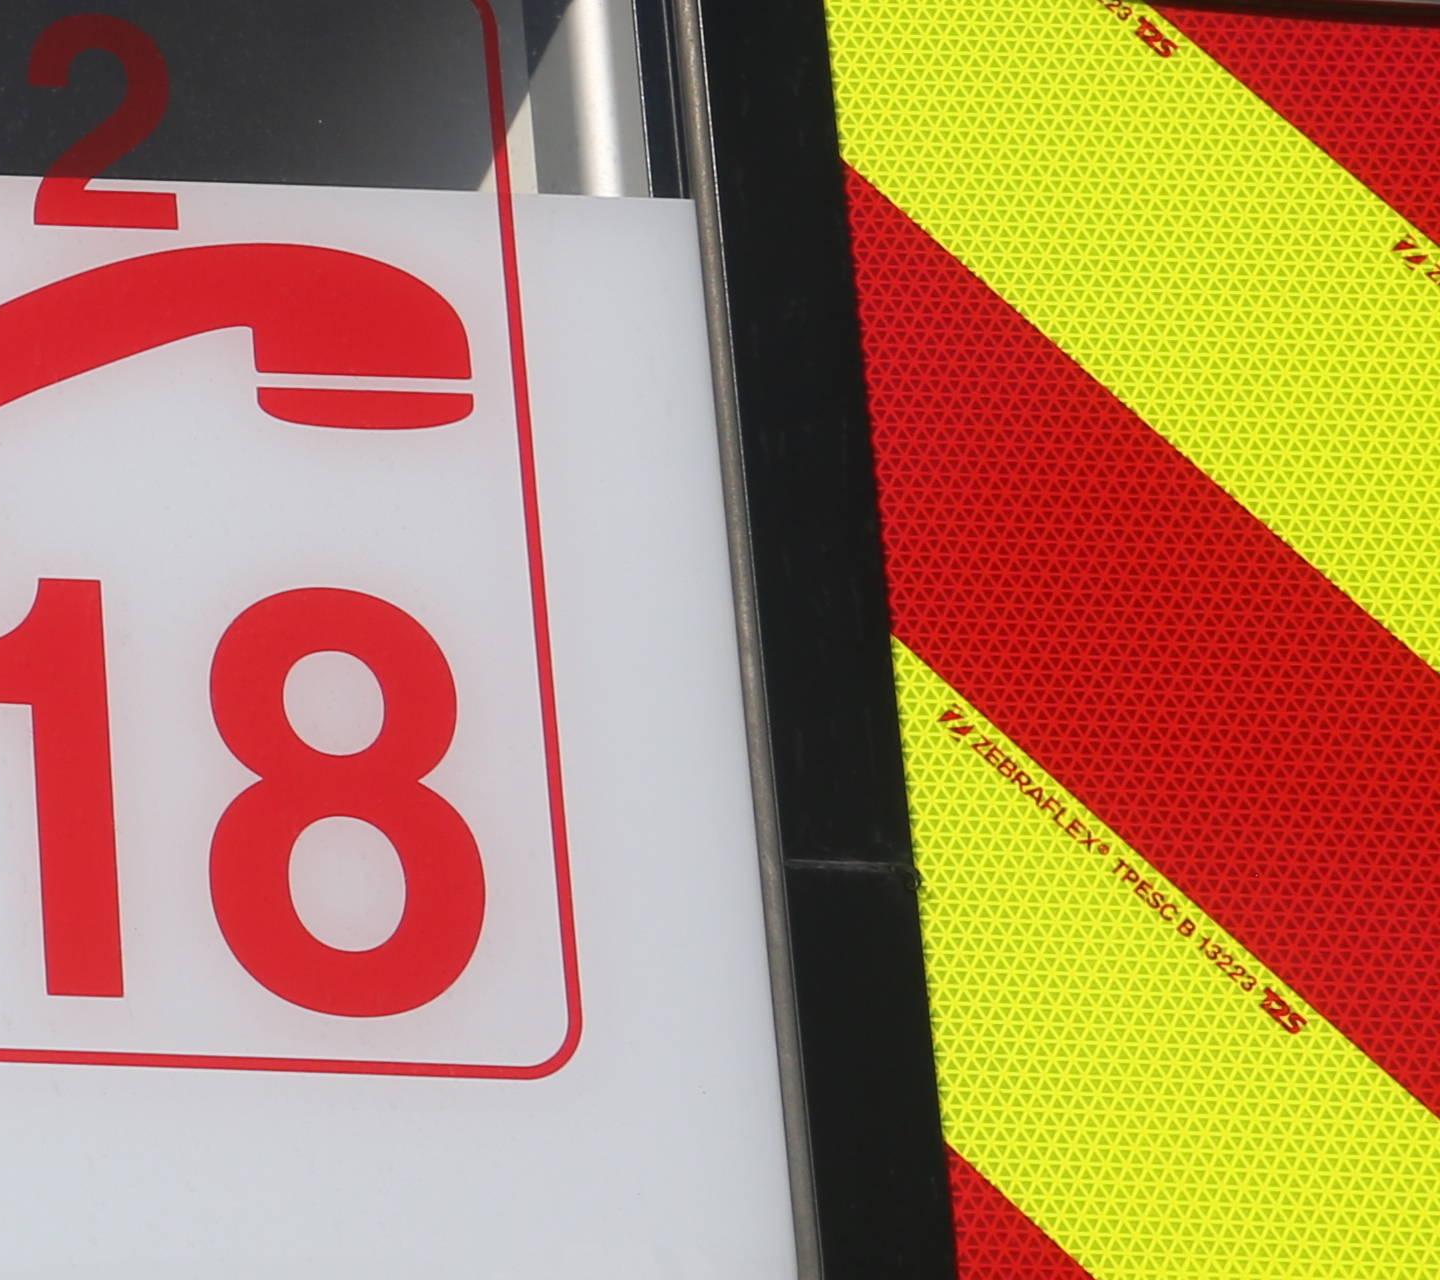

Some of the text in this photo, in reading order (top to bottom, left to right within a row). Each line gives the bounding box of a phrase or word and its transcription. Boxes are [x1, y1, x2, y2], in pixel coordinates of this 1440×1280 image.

[1112, 858, 1179, 921] TPESC
[1176, 918, 1197, 938] B
[1198, 935, 1259, 993] 13223
